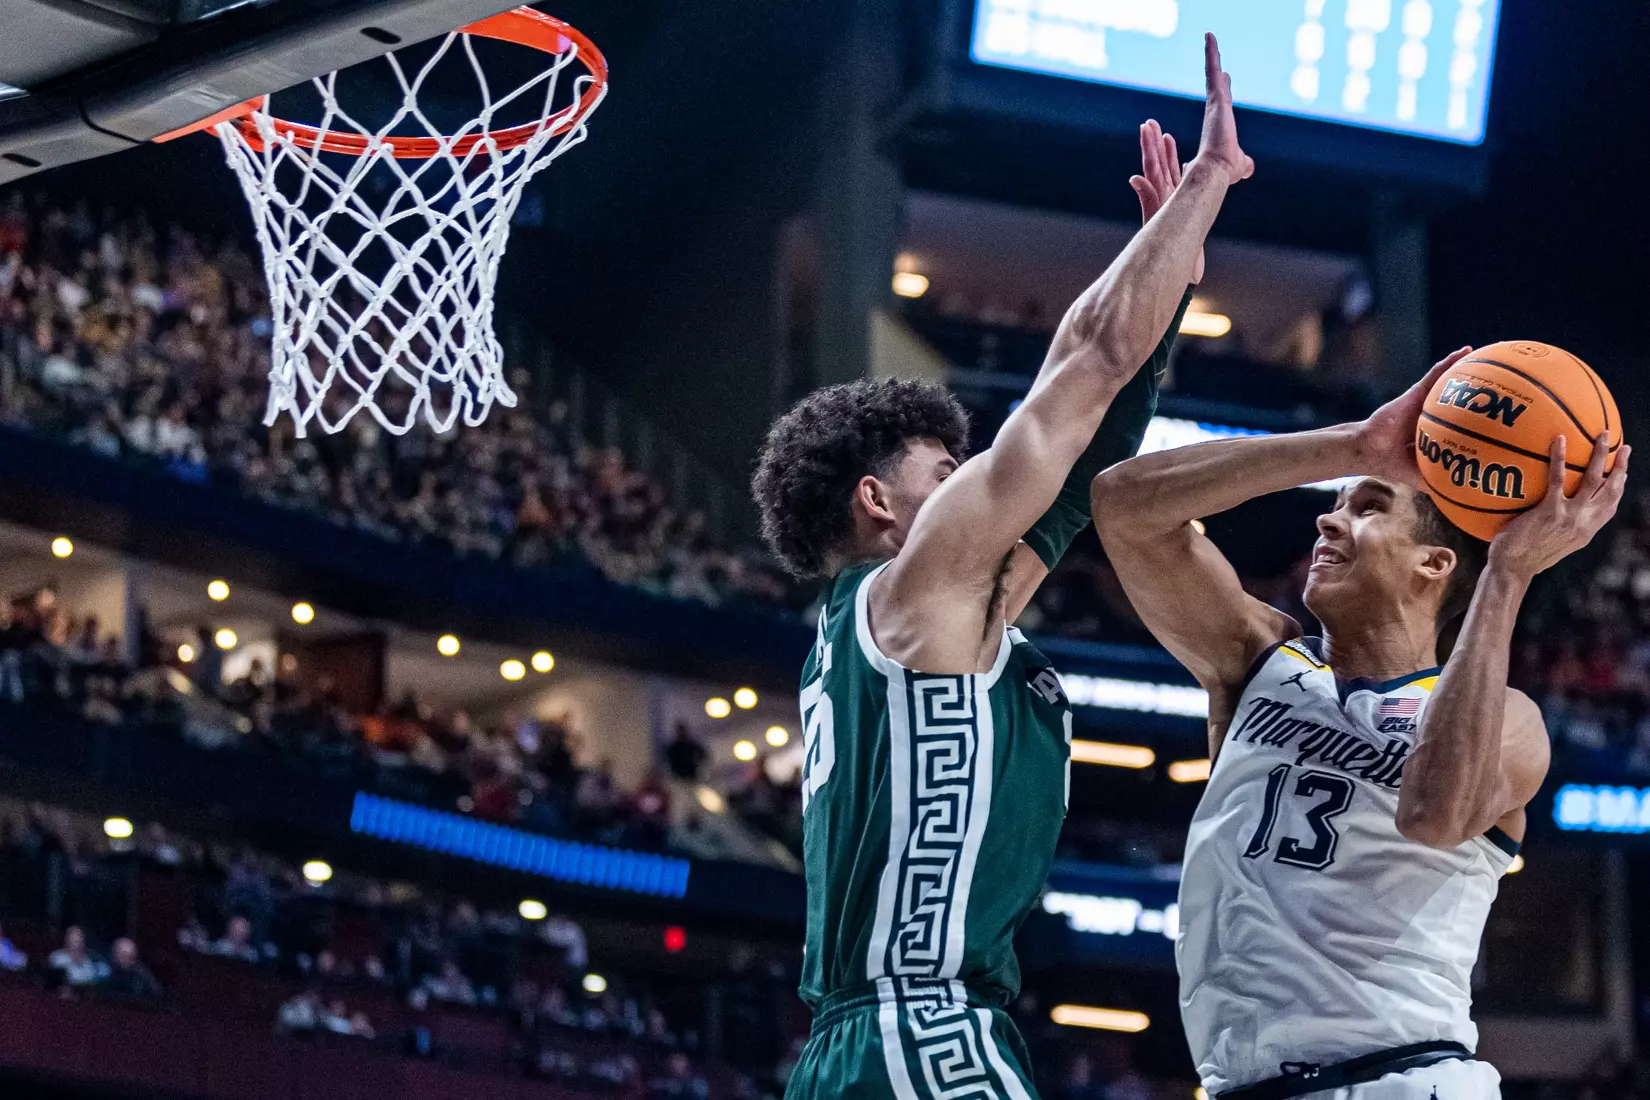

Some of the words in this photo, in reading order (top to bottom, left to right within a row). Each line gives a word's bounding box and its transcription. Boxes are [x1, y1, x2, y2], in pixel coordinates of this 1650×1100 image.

[1437, 377, 1529, 428] NCAA
[1418, 426, 1526, 500] Wilson
[1377, 723, 1417, 734] EAST
[1382, 716, 1412, 724] BIG
[1243, 763, 1356, 871] 13
